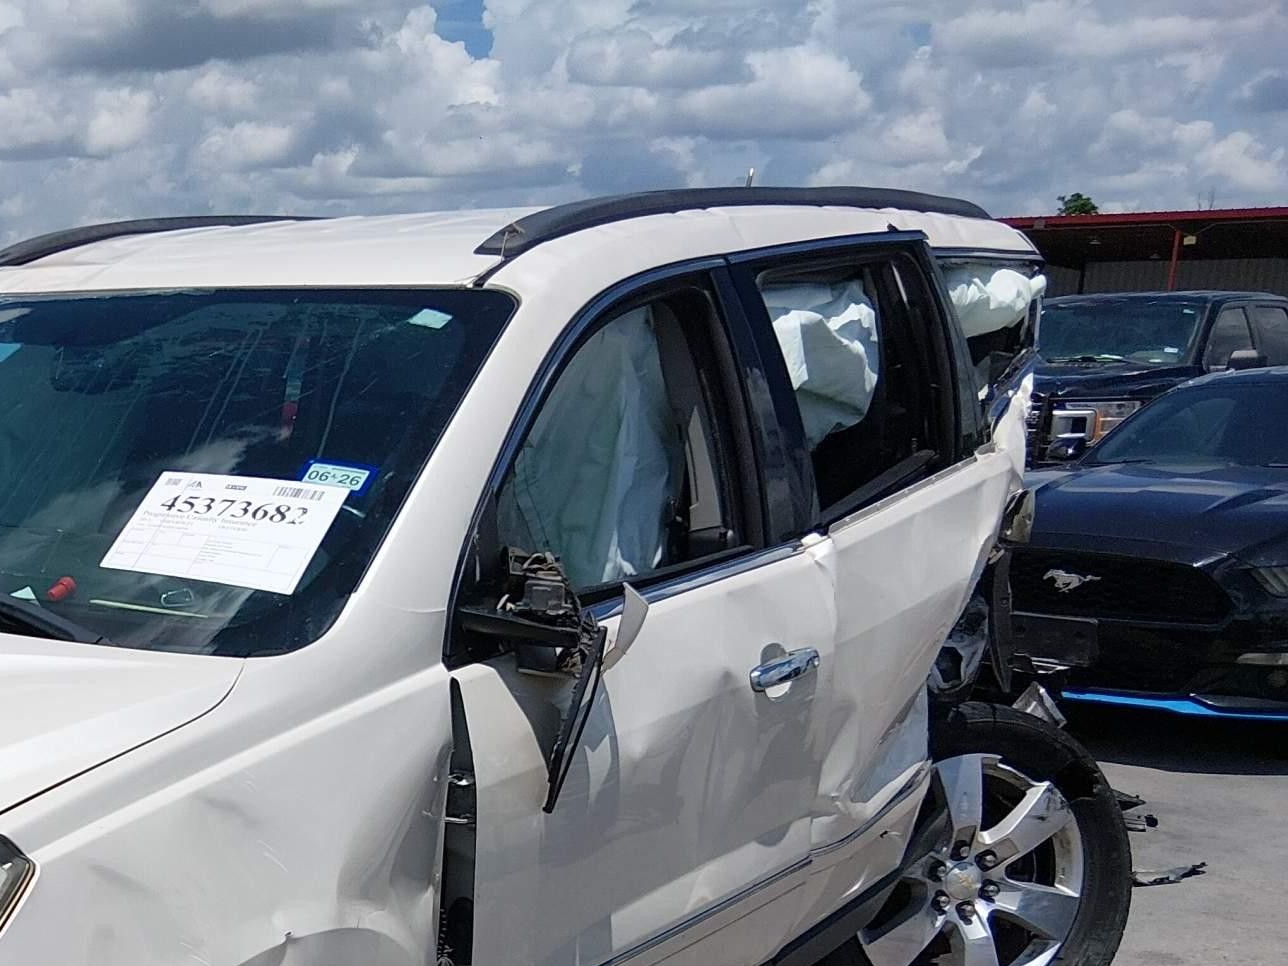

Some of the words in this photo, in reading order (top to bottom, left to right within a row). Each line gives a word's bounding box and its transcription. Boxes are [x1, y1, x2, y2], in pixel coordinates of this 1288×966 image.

[307, 470, 331, 482] 06
[336, 473, 362, 486] 26
[160, 494, 309, 525] 45373682
